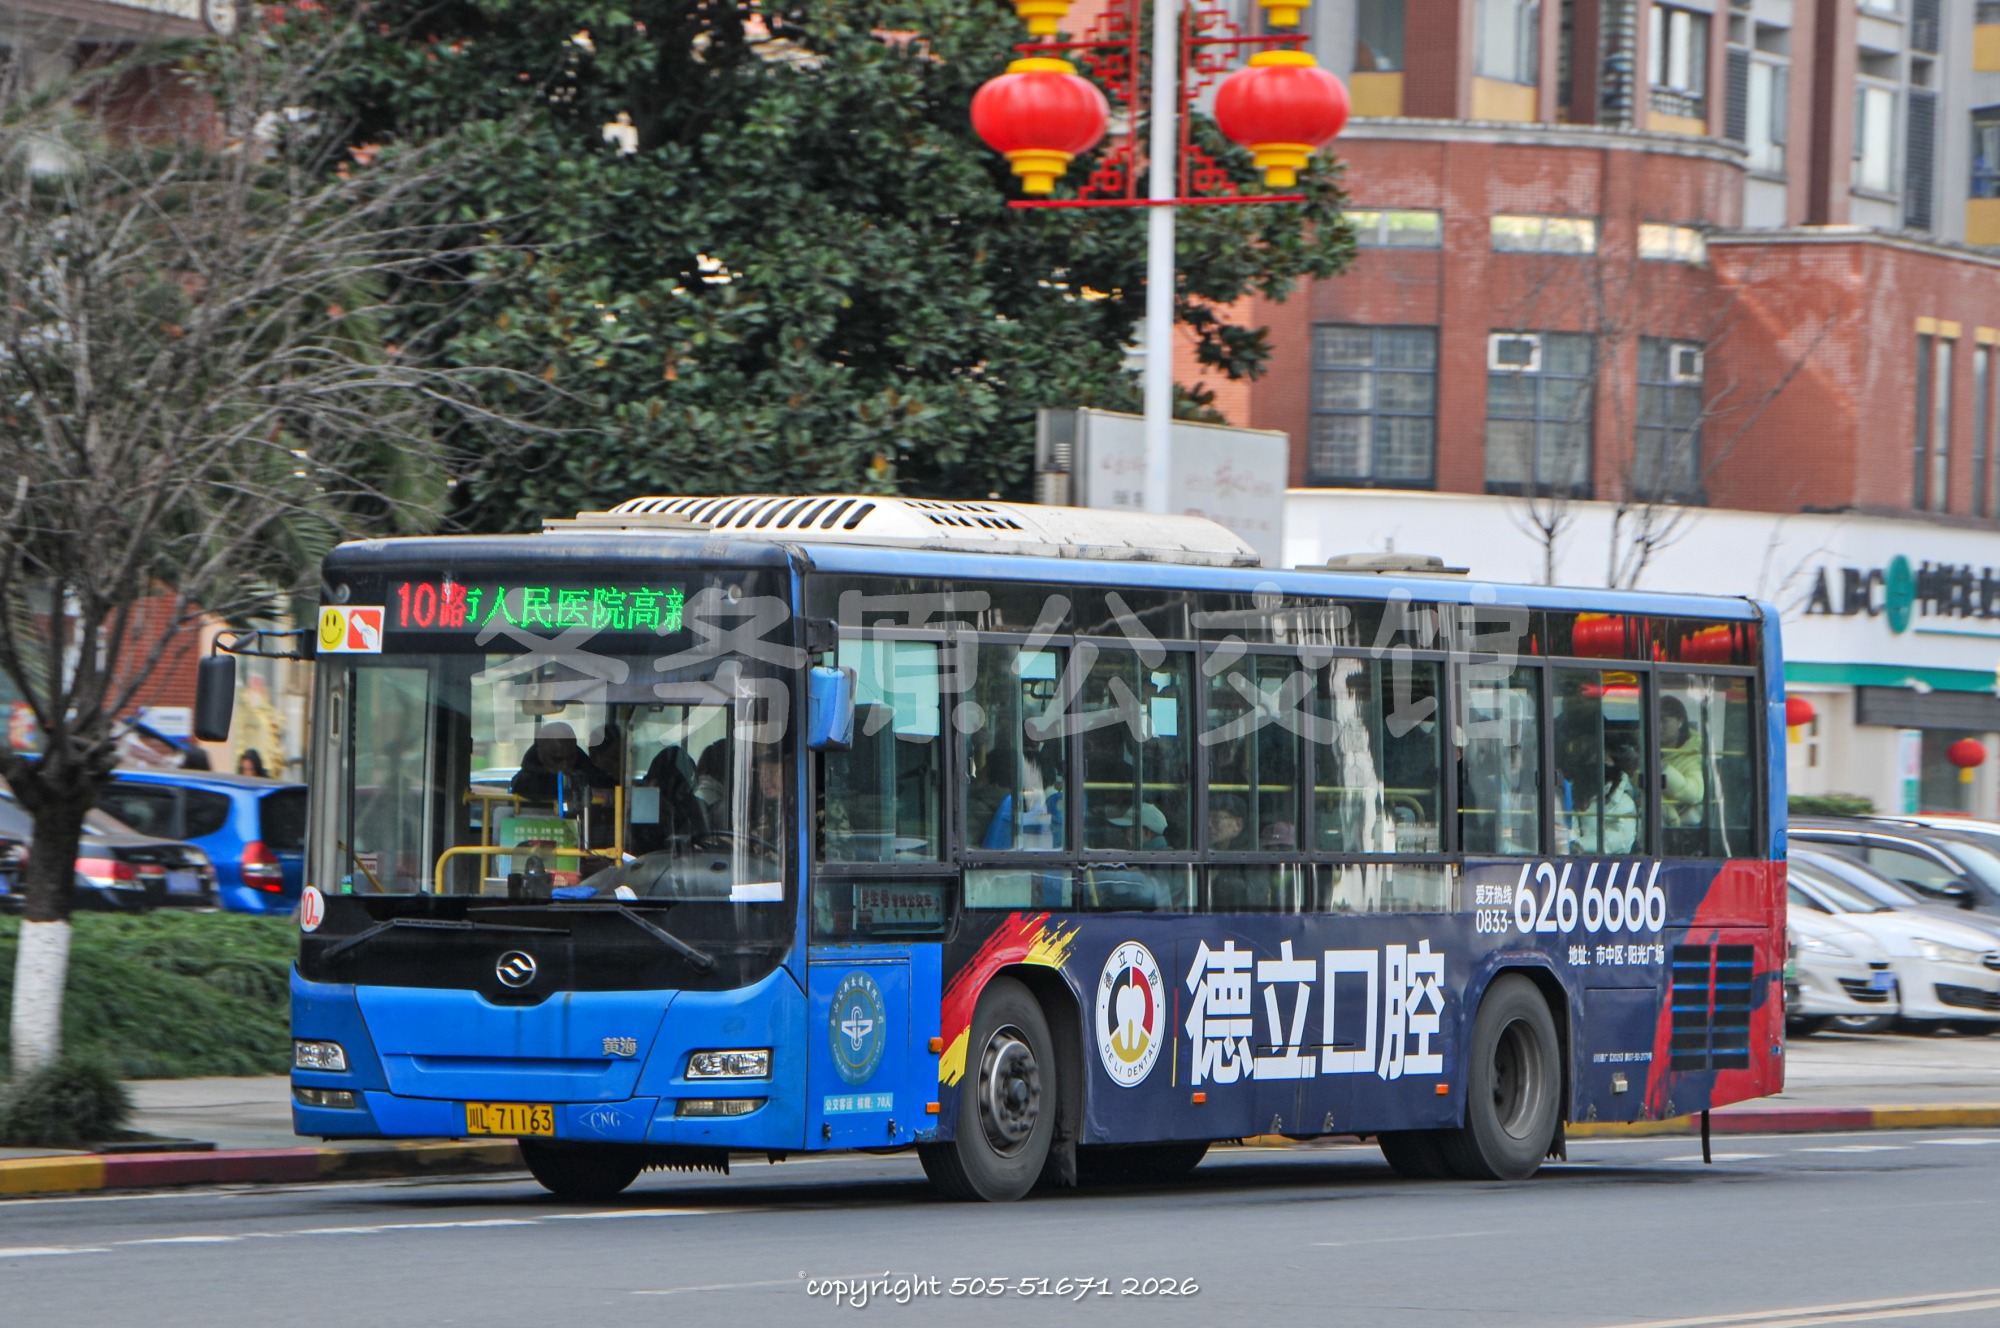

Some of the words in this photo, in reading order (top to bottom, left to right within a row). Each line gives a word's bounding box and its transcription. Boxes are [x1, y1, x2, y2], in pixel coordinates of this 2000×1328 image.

[397, 582, 467, 628] 10路
[1475, 885, 1513, 905] 爱牙热线
[1184, 939, 1446, 1087] 德立口腔
[601, 1036, 638, 1057] 黄海
[1127, 1041, 1157, 1078] DENTAL
[590, 1111, 621, 1129] CNG
